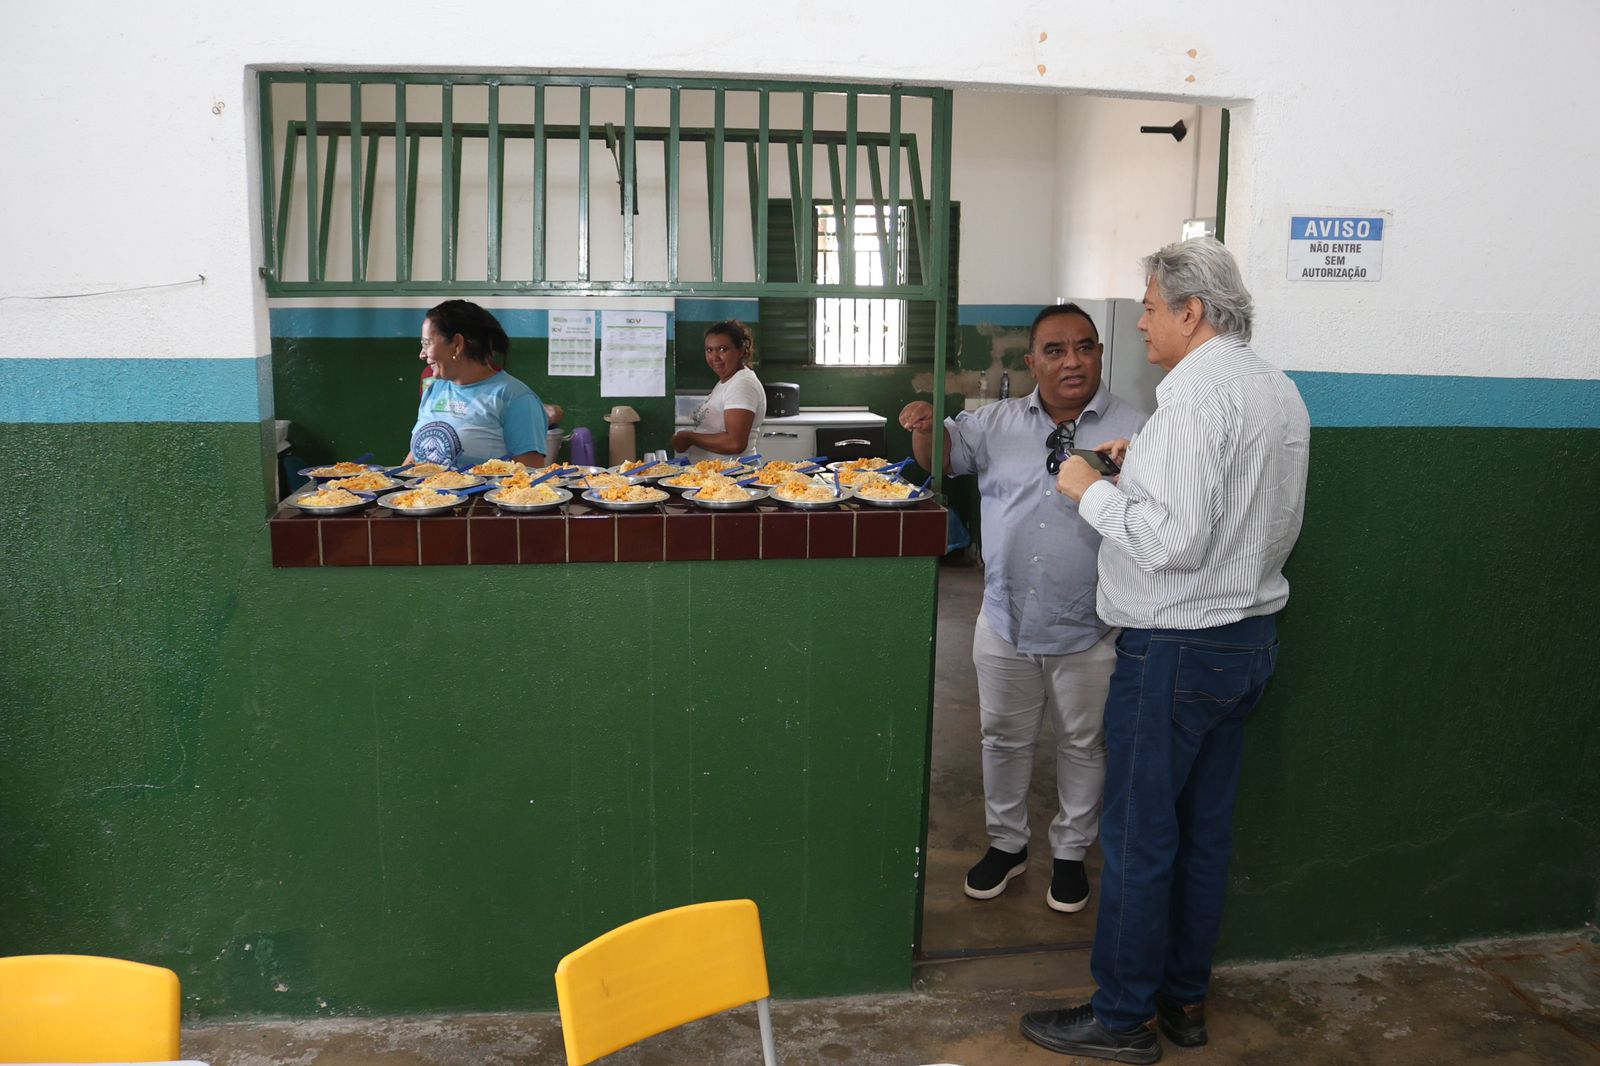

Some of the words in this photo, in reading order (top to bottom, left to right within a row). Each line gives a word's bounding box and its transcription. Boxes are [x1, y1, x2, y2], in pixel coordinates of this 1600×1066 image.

[1304, 220, 1371, 238] AVISO
[1310, 241, 1329, 253] NÃO
[1332, 243, 1362, 253] ENTRE
[1325, 256, 1345, 266] SEM
[1302, 266, 1367, 280] AUTORIZAÇÃO
